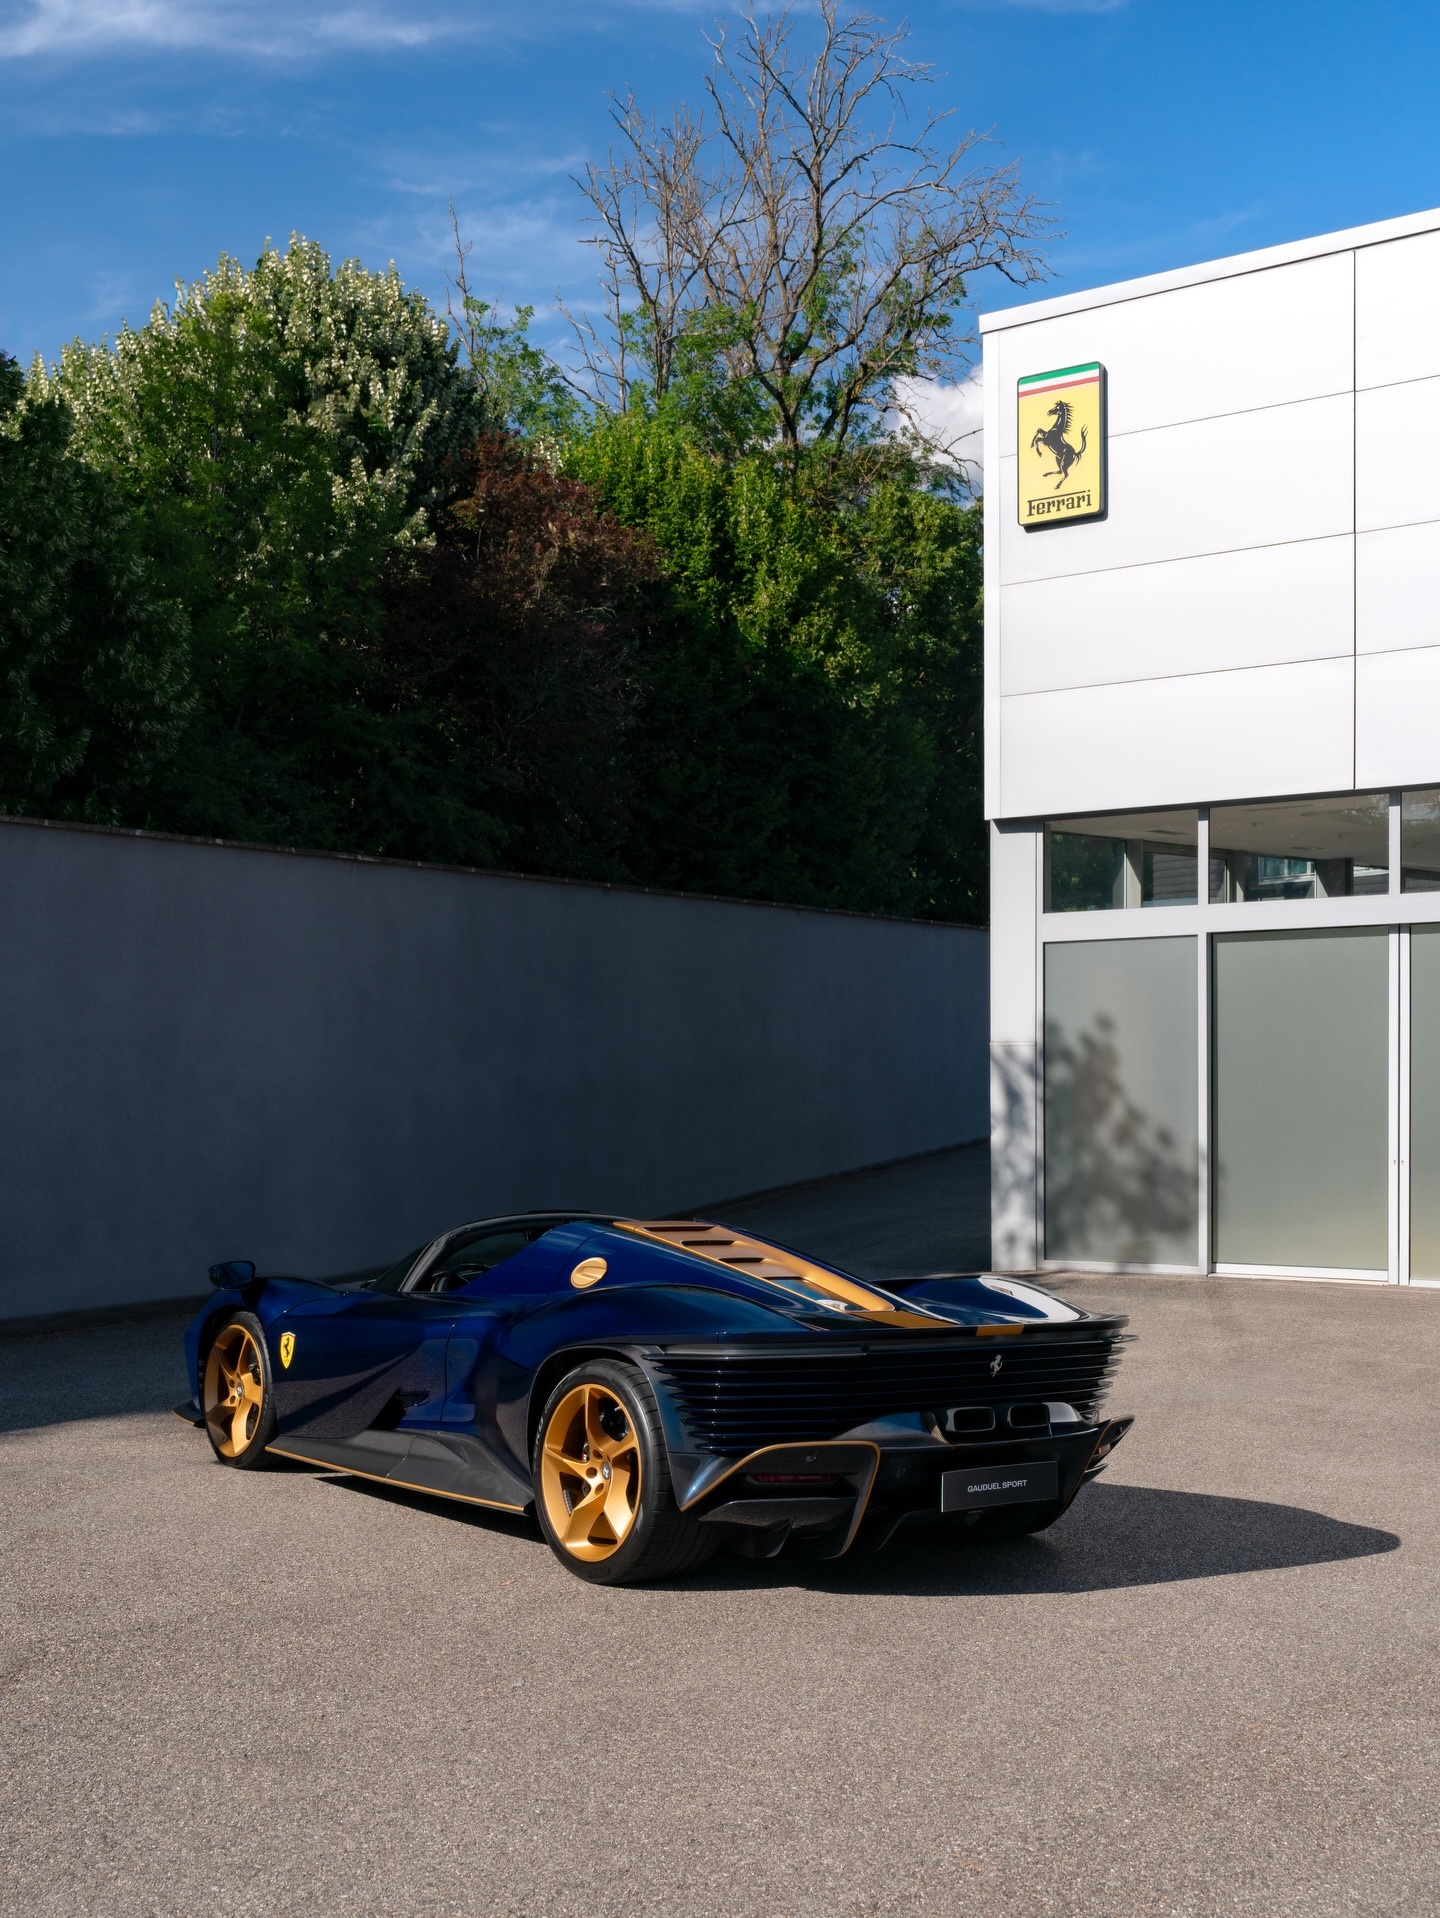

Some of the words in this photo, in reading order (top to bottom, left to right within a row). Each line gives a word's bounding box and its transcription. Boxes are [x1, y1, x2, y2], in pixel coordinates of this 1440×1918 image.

[1026, 489, 1092, 517] Ferrari
[967, 1482, 1001, 1493] GAUDUEL
[1002, 1479, 1028, 1489] SPORT
